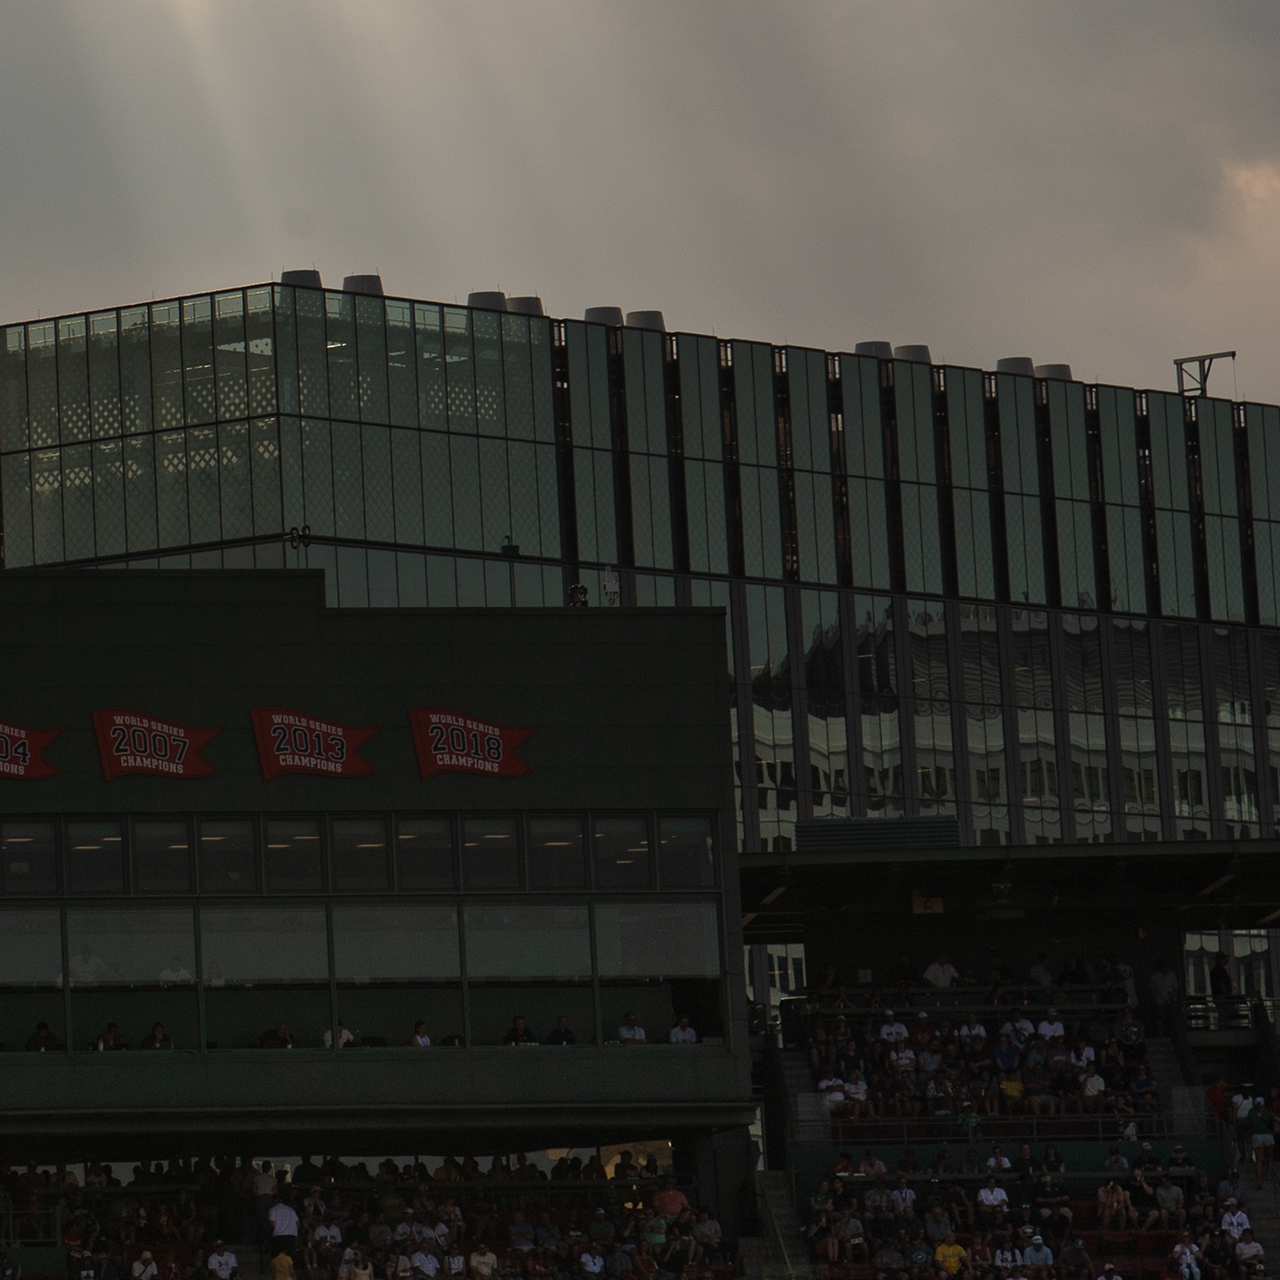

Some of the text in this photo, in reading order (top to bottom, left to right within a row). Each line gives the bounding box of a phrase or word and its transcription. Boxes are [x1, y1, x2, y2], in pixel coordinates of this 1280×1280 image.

[113, 715, 186, 737] WORLD SERIES
[272, 715, 344, 736] WORLD SERIES
[429, 714, 501, 736] WORLD SERIES
[110, 726, 190, 764] 2007
[270, 725, 347, 762] 2013
[427, 725, 503, 762] 2018
[120, 756, 185, 774] CHAMPIONS
[278, 755, 343, 773] CHAMPIONS
[436, 754, 500, 772] CHAMPIONS
